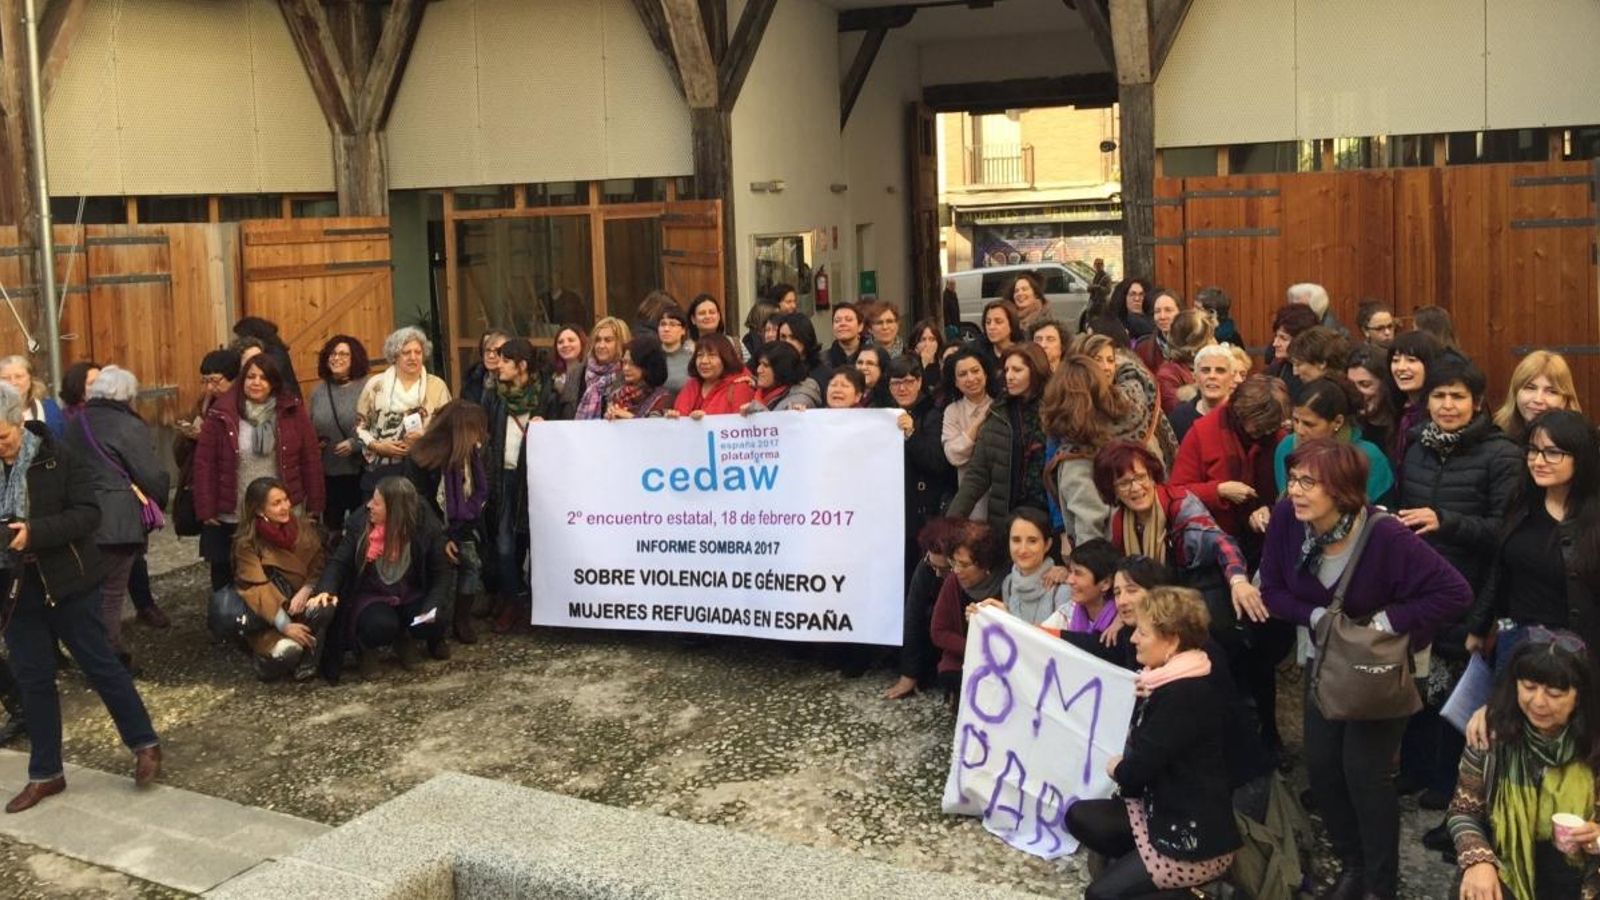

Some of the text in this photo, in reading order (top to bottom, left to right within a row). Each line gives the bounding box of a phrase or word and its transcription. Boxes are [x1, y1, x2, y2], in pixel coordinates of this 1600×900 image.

[720, 425, 779, 439] sombra
[758, 439, 779, 448] 2017
[641, 430, 779, 492] cedaw
[721, 450, 780, 462] plataforma
[586, 511, 663, 525] encuentro
[667, 510, 717, 527] estatal,
[722, 511, 737, 525] 18
[741, 510, 756, 525] de
[759, 510, 806, 525] febrero
[811, 510, 854, 526] 2017
[636, 539, 780, 555] INFORME SOMBRA 2017
[574, 568, 846, 593] SOBRE VIOLENCIA DE GÉNERO Y
[569, 602, 853, 631] MUJERES REFUGIADAS EN ESPAÑA
